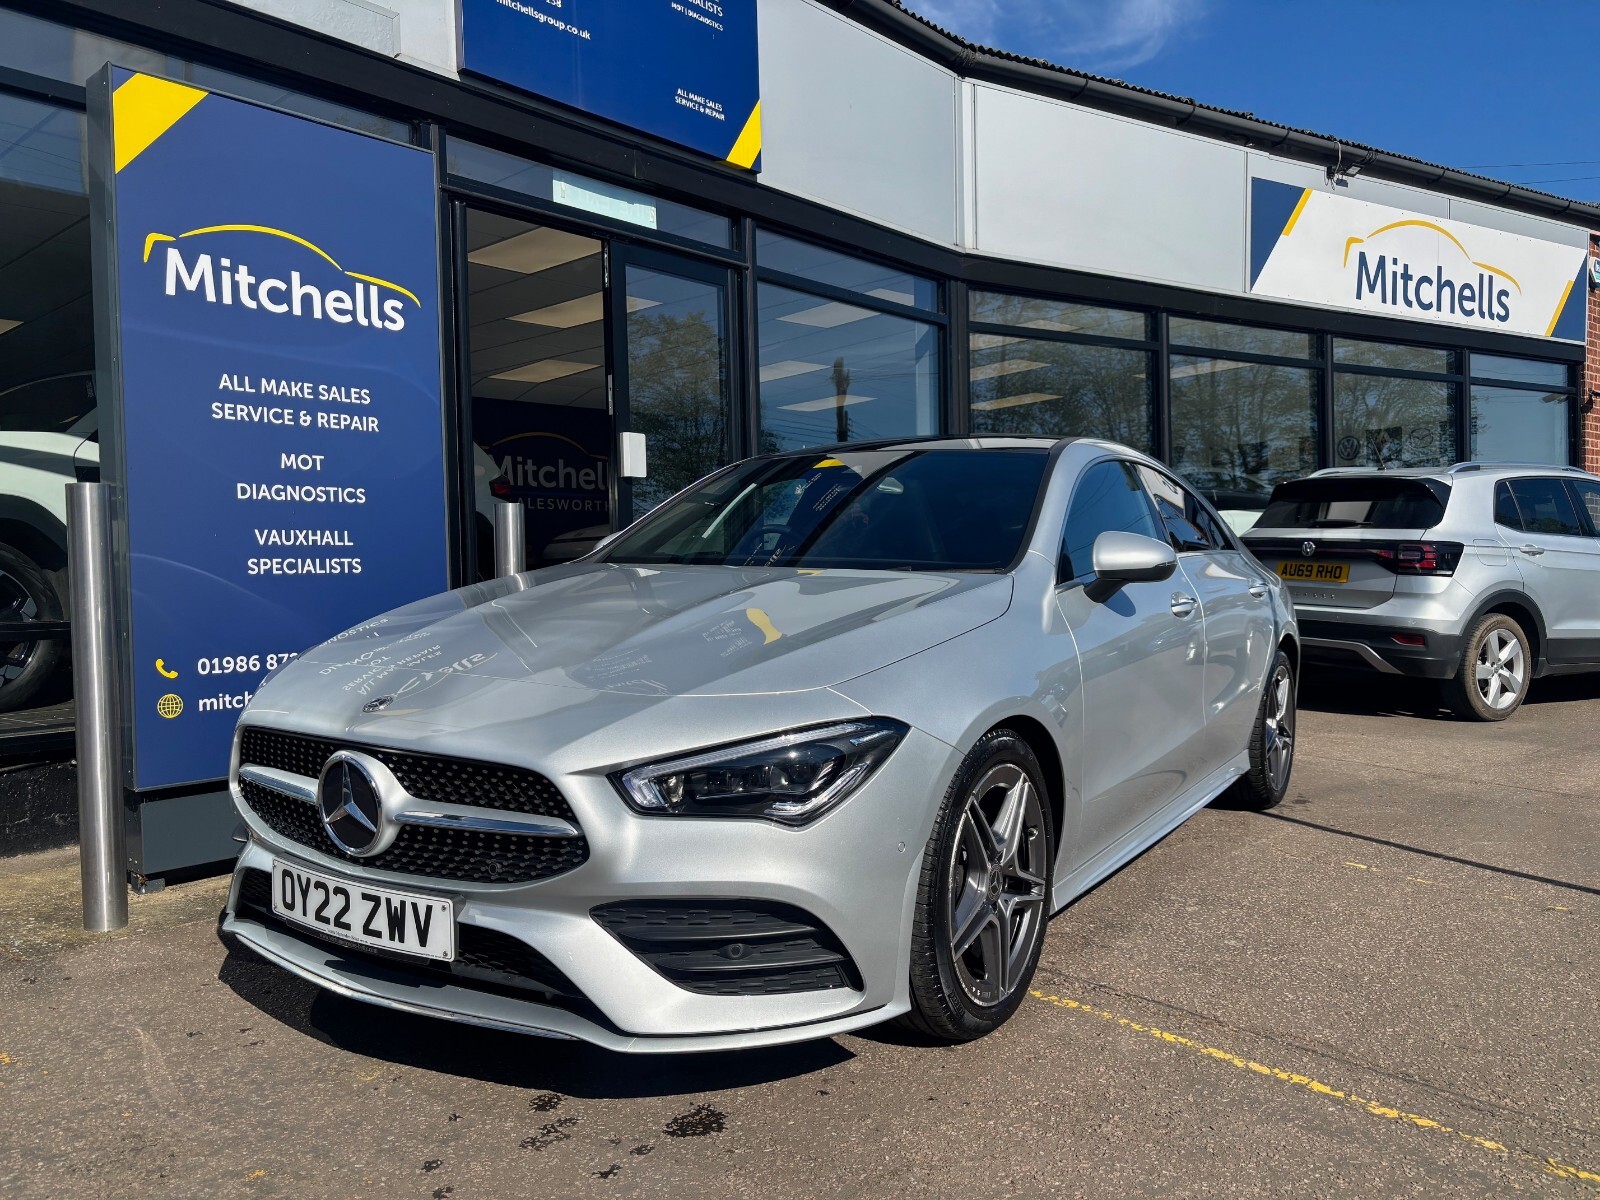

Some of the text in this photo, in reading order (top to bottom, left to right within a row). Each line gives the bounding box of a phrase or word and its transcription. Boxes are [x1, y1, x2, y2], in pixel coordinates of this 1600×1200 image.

[671, 2, 684, 12] MOT
[688, 9, 724, 31] DIAGNOSTICS
[675, 95, 699, 111] SERVICE
[705, 107, 725, 121] REPAIR
[677, 88, 723, 111] ALL MAKE SALES
[165, 247, 405, 331] Mitchells
[1356, 251, 1510, 323] Mitchells
[218, 373, 371, 405] ALL MAKE SALES
[211, 402, 380, 433] SERVICE & REPAIR
[280, 452, 325, 471] MOT
[236, 482, 366, 504] DIAGNOSTICS
[254, 528, 354, 546] VAUXHALL
[247, 558, 362, 575] SPECIALISTS
[1280, 562, 1313, 578] AU69
[197, 654, 261, 675] 01986
[266, 652, 299, 670] 87
[281, 868, 433, 948] OY22 ZWV
